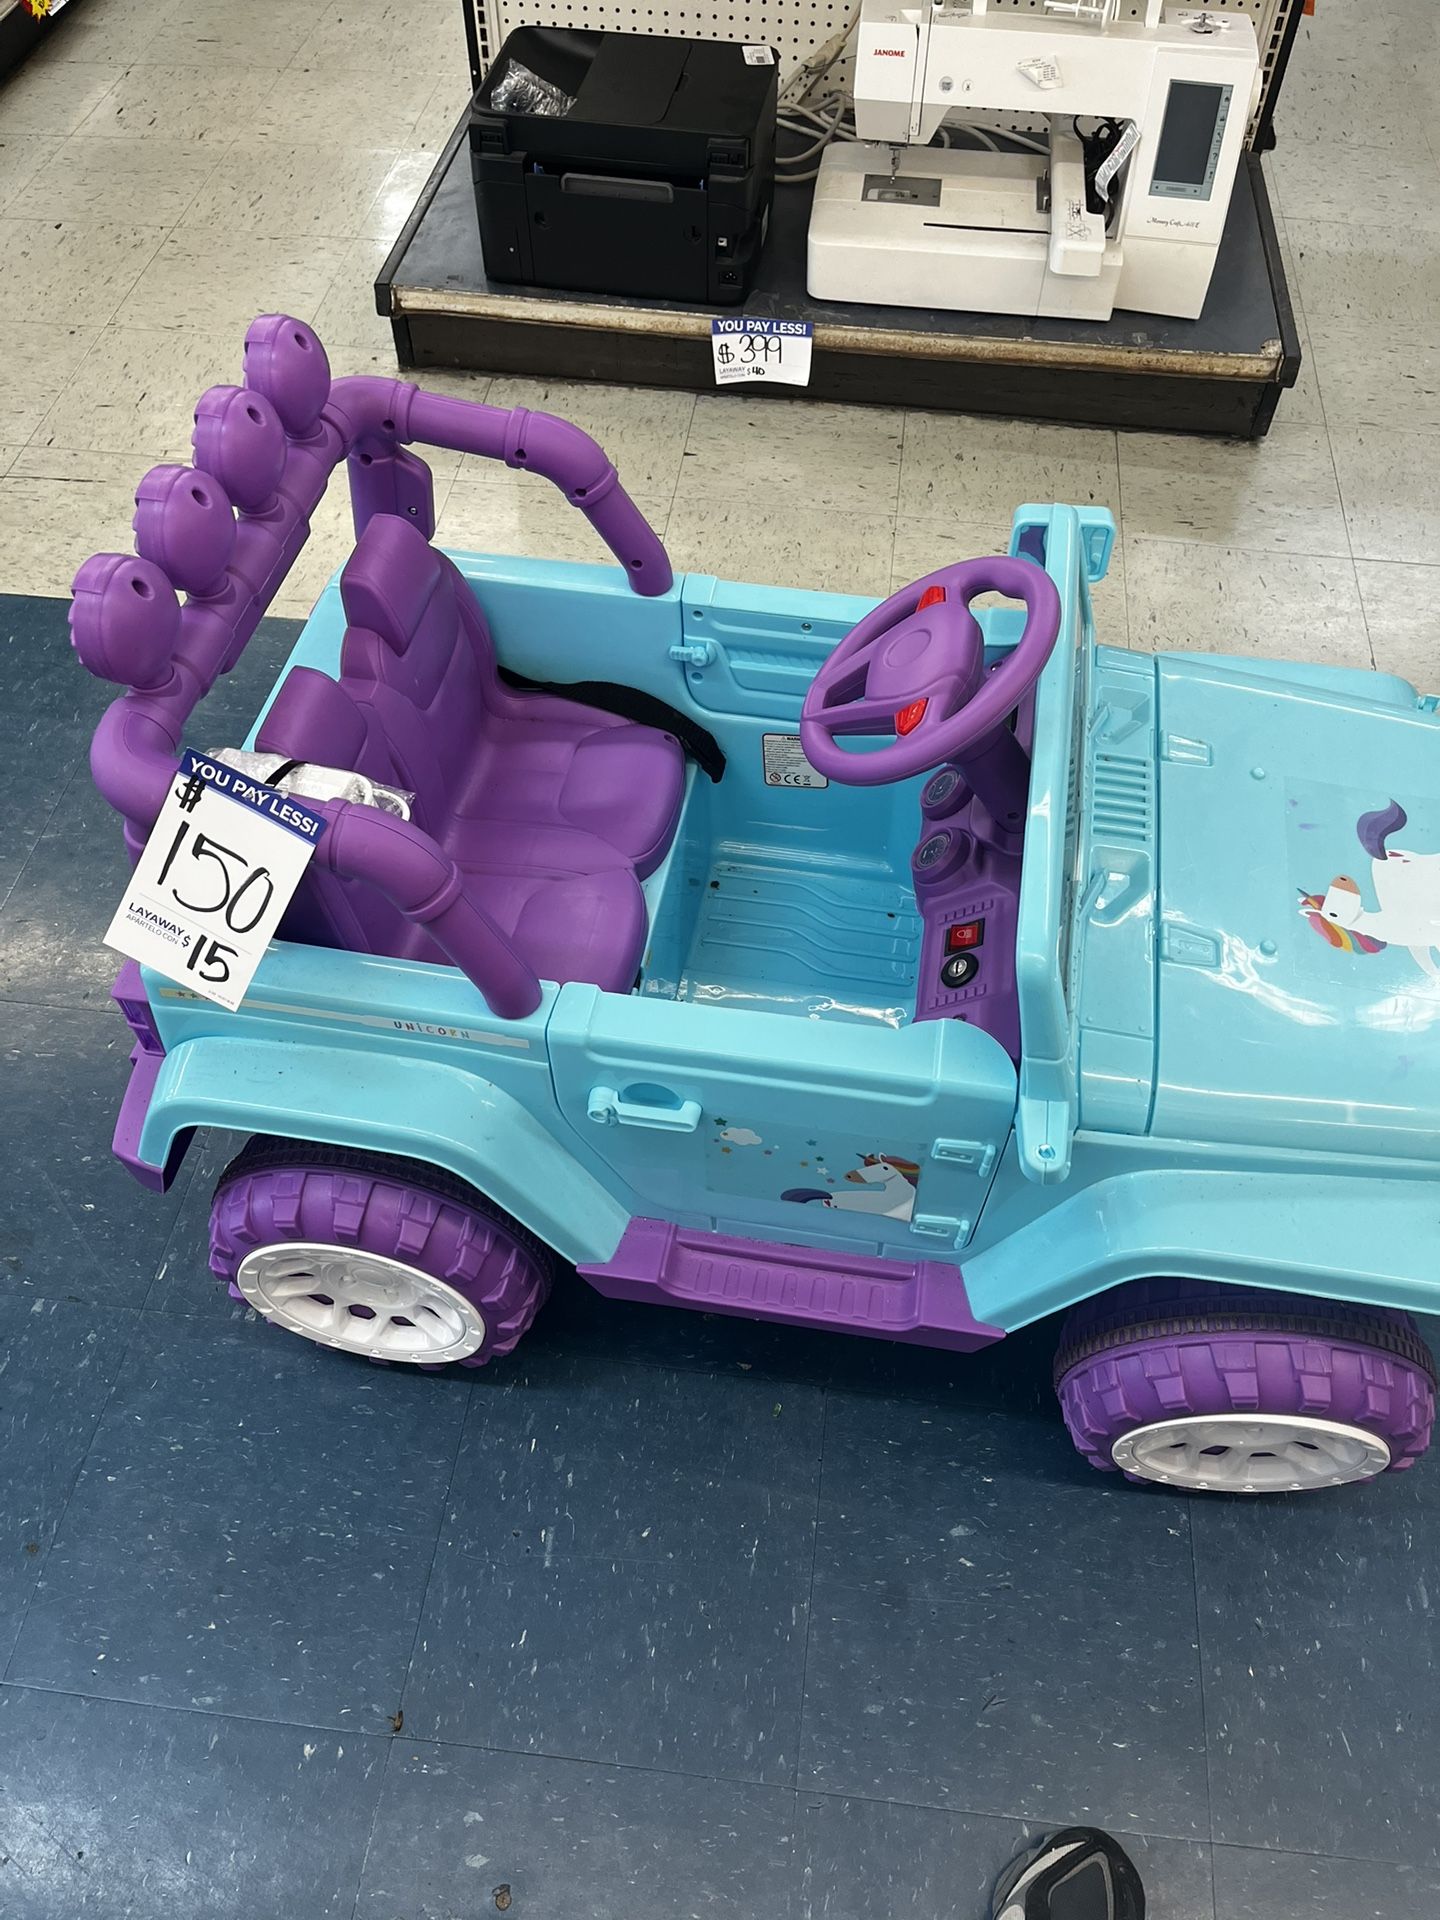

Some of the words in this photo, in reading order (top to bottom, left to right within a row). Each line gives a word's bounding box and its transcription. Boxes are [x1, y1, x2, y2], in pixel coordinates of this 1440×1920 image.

[873, 48, 906, 58] JANOME
[717, 320, 744, 332] YOU
[746, 321, 771, 333] PAY
[773, 322, 807, 335] LESS!
[719, 366, 746, 375] LAYAWAY
[190, 757, 231, 787] YOU
[231, 779, 271, 807] PAY
[269, 798, 320, 837] LESS!
[157, 820, 273, 934] 150
[128, 902, 185, 936] LAYAWAY
[162, 931, 179, 945] CON
